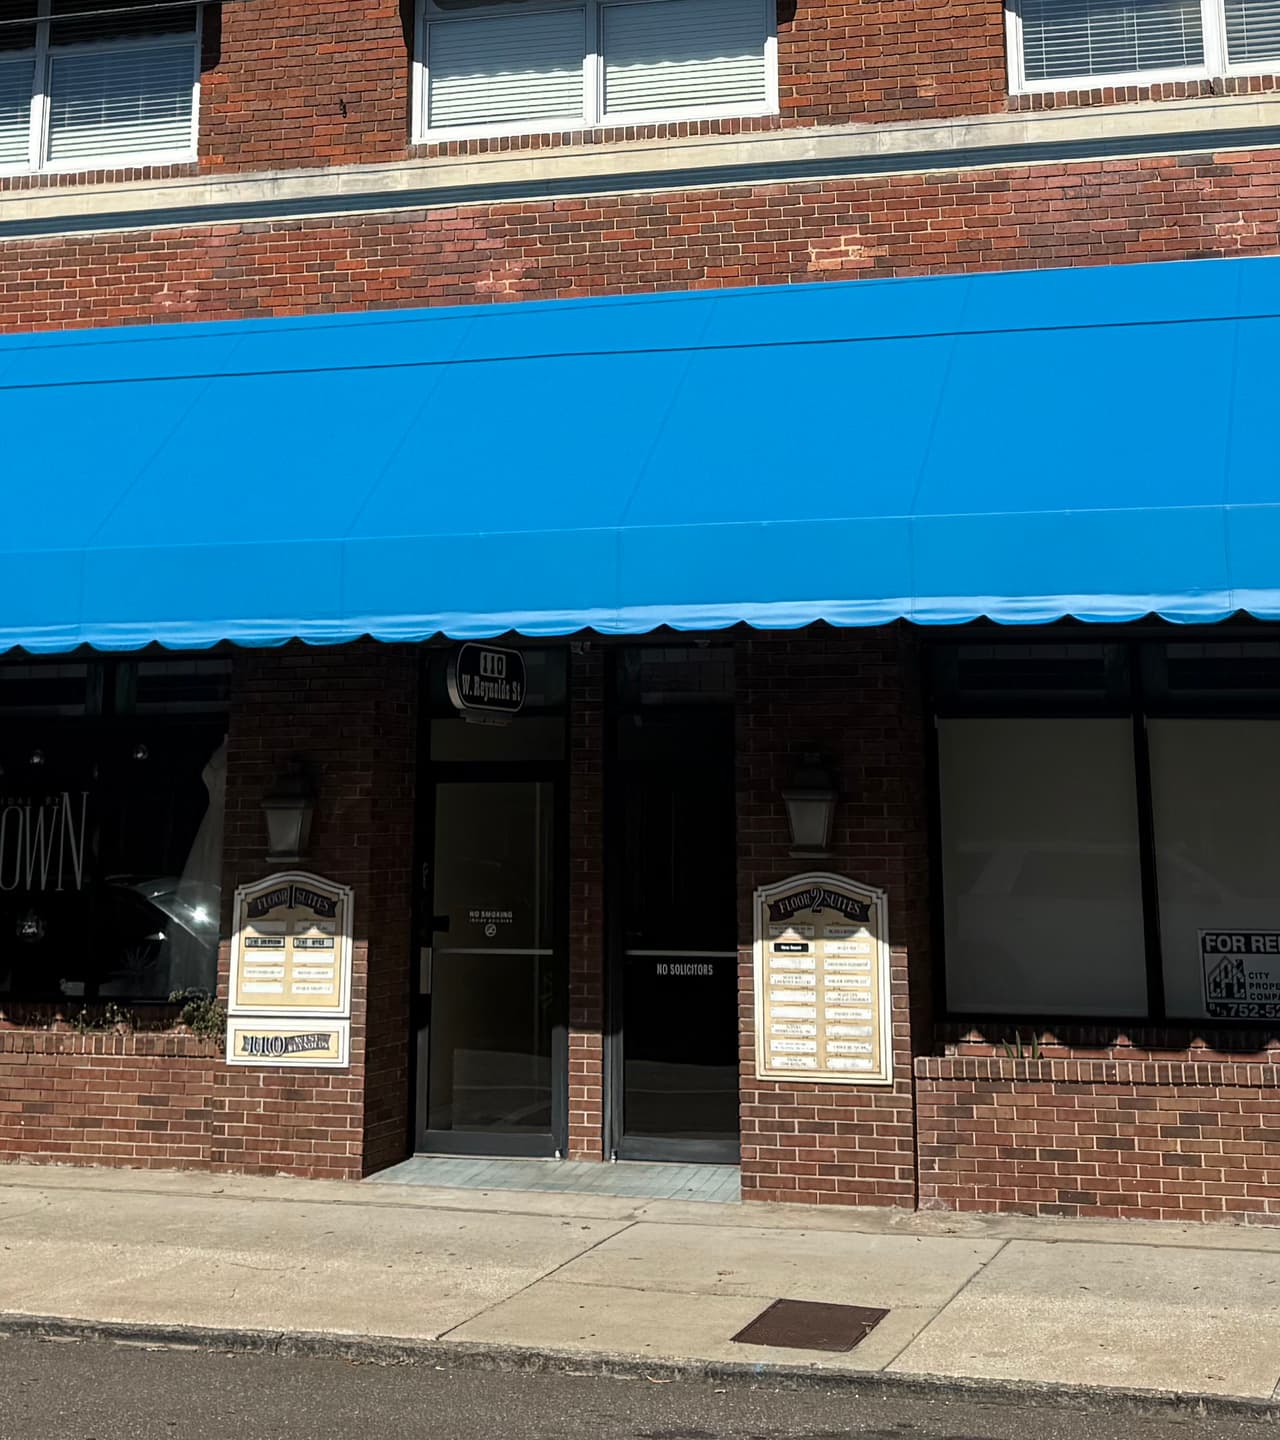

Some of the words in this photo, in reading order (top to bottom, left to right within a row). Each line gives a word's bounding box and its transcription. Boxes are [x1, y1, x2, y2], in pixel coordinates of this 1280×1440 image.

[484, 656, 503, 675] 110
[462, 674, 472, 696] W.
[474, 675, 511, 702] Reynolds
[511, 680, 521, 702] St
[256, 889, 288, 911] FLOOR
[296, 889, 329, 912] SUITES
[779, 893, 811, 914] FLOOR
[810, 888, 825, 914] 2
[824, 893, 861, 914] SUITES
[1205, 935, 1246, 952] FOR
[656, 963, 668, 976] NO
[669, 963, 714, 976] SOLICITORS
[1248, 972, 1270, 980] CITY
[248, 1035, 285, 1057] 110
